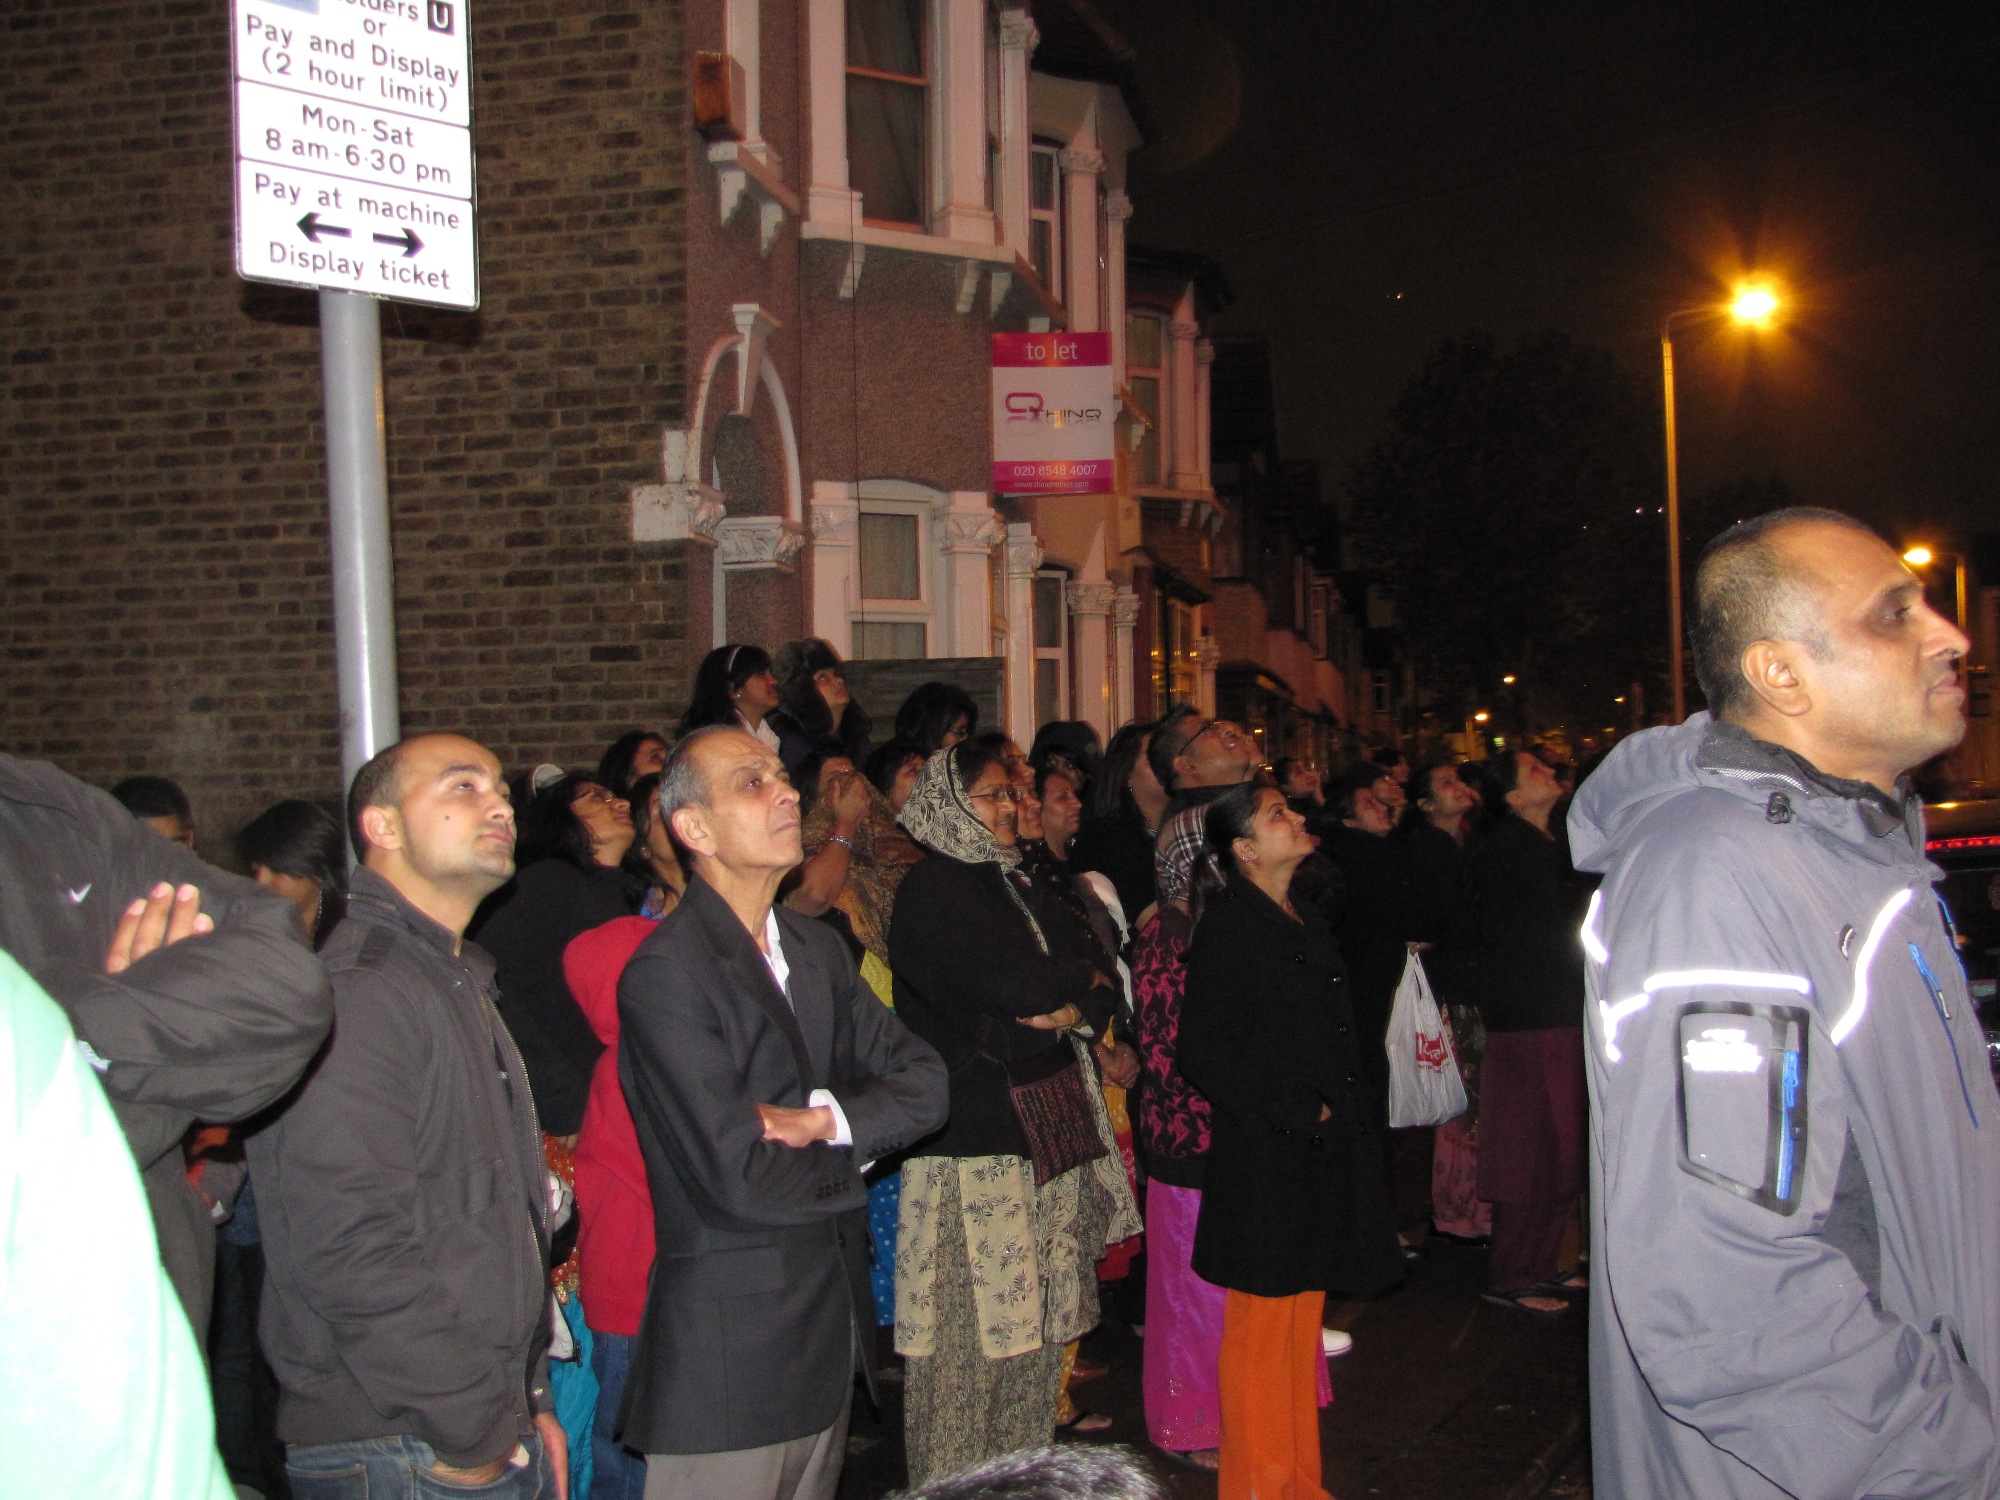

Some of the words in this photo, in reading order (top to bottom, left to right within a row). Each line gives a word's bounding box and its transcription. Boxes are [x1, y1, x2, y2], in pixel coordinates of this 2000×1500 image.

[338, 0, 419, 21] ders
[363, 18, 387, 37] or
[246, 13, 293, 49] Pay
[309, 34, 355, 60] and
[371, 44, 459, 88] Display
[261, 46, 292, 76] (2
[308, 60, 365, 92] hour
[380, 76, 448, 113] limit)
[302, 103, 415, 148] Mon-Sat
[265, 128, 282, 151] 8
[416, 163, 451, 184] pm
[255, 172, 301, 205] Pay
[317, 187, 343, 209] at
[358, 196, 460, 229] machine
[269, 241, 364, 281] Display
[380, 259, 450, 290] ticket
[1026, 342, 1046, 360] to
[1053, 339, 1078, 360] let
[1014, 465, 1035, 476] 020
[1038, 465, 1066, 476] 8548
[1069, 464, 1098, 476] 4007
